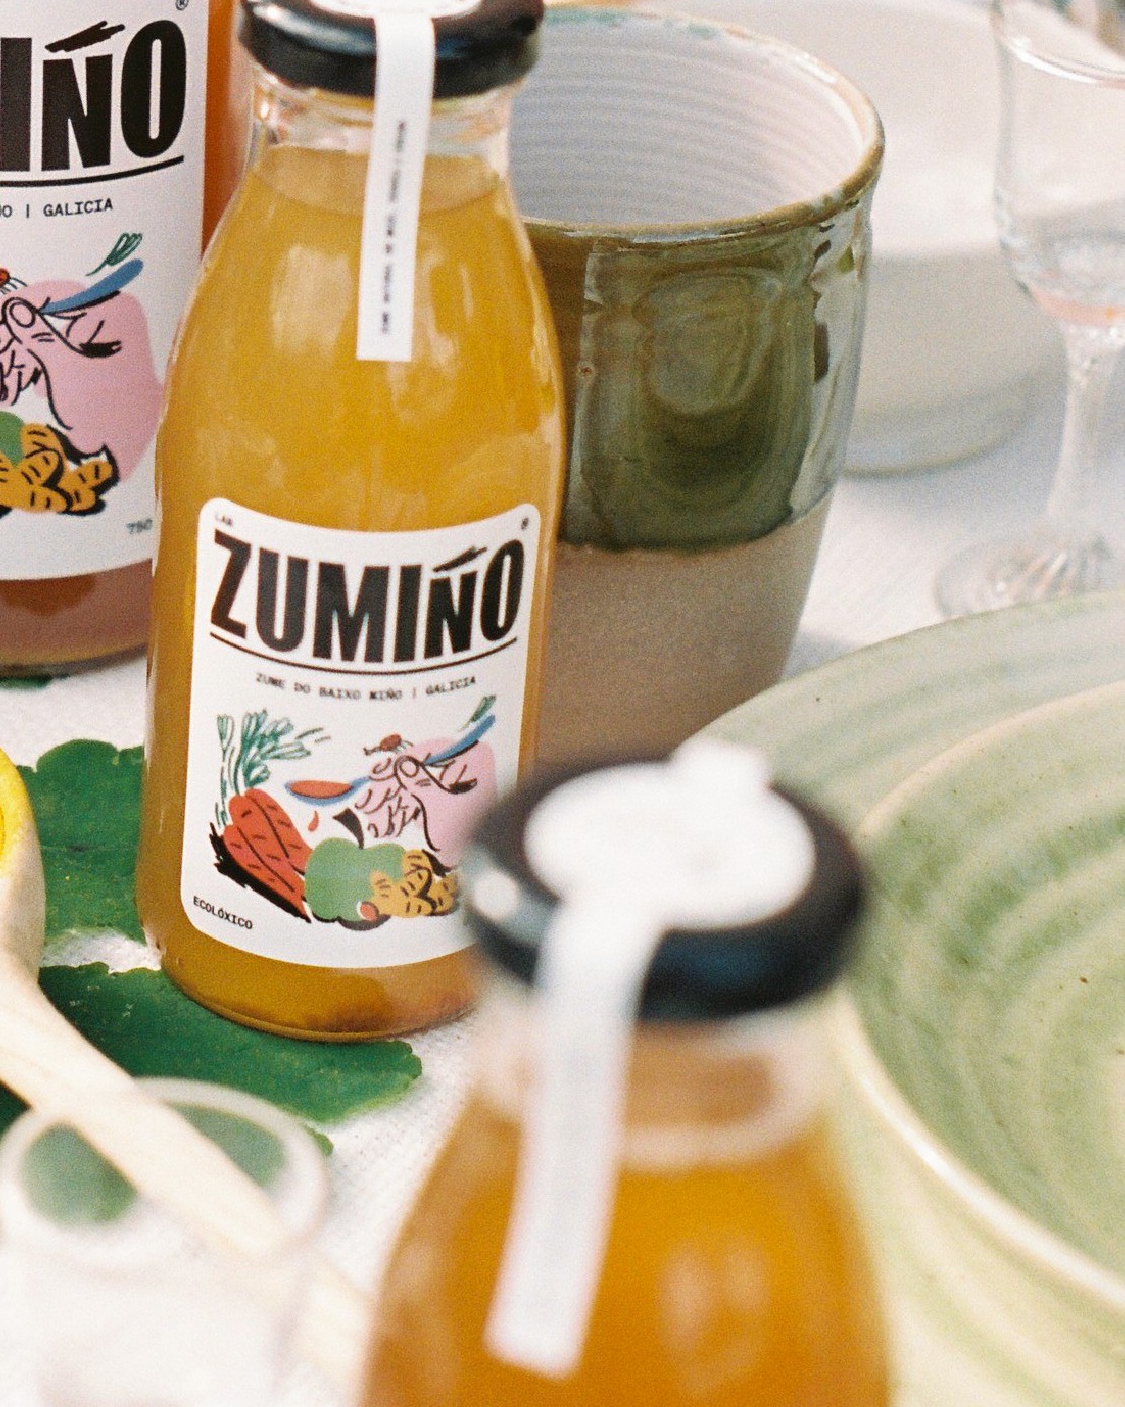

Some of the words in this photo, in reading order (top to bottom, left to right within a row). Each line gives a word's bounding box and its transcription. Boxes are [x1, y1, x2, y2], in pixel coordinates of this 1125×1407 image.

[43, 198, 113, 217] GALICIA
[210, 529, 525, 663] ZUMIÑO
[256, 672, 285, 688] ZUME
[294, 682, 311, 694] DO
[319, 687, 361, 700] BAIXO
[369, 687, 402, 701] MIÑO
[425, 676, 476, 695] GALICIA
[193, 895, 253, 929] ECOLÓXICO
